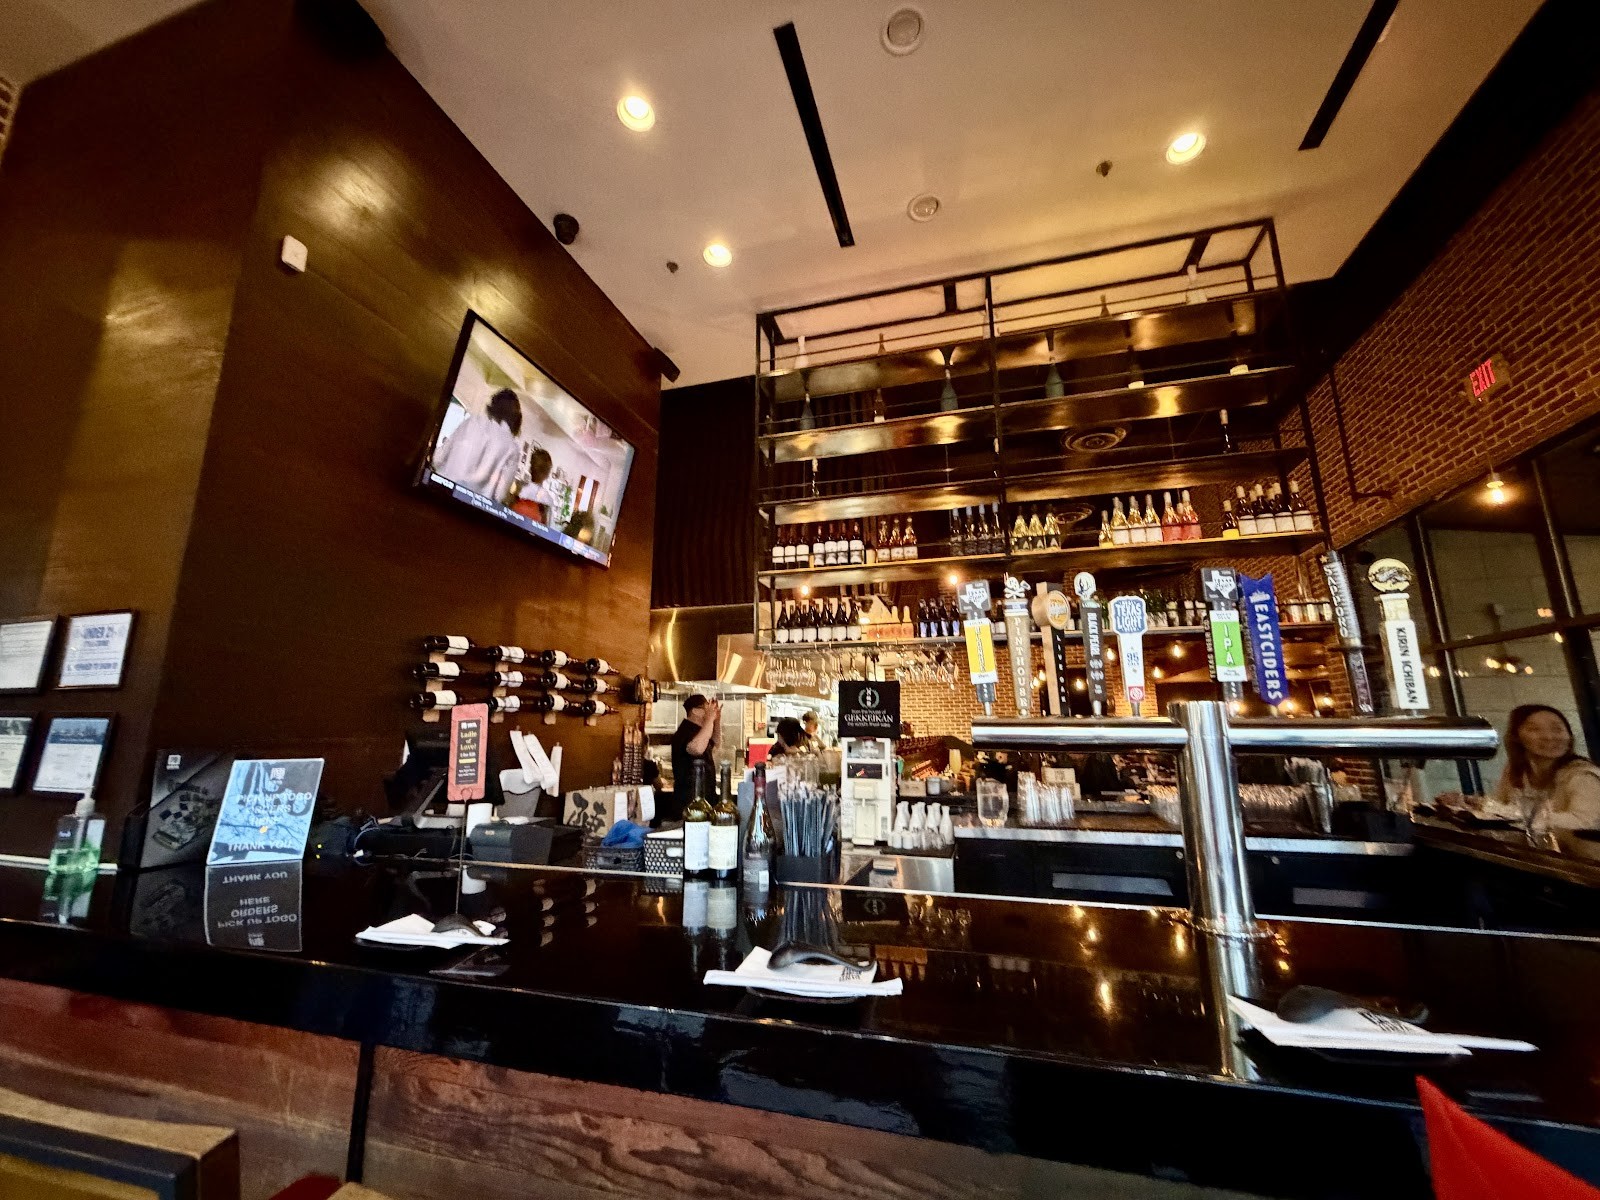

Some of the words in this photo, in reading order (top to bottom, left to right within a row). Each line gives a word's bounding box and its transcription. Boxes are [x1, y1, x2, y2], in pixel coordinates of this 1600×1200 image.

[1470, 358, 1496, 397] EXIT
[1115, 602, 1142, 617] TEXAS
[1323, 565, 1349, 638] SAPPORO
[1087, 612, 1099, 634] BLACK
[1117, 615, 1142, 630] LIGHT
[1089, 634, 1101, 657] PEARL
[1223, 623, 1236, 666] IPA
[1254, 603, 1283, 700] EASTCIDERS
[1396, 627, 1411, 656] KIRIN
[1401, 661, 1419, 704] ICHIBAN
[844, 713, 894, 723] GEKKEIKAN
[228, 843, 265, 852] THANK
[269, 840, 293, 849] YOU
